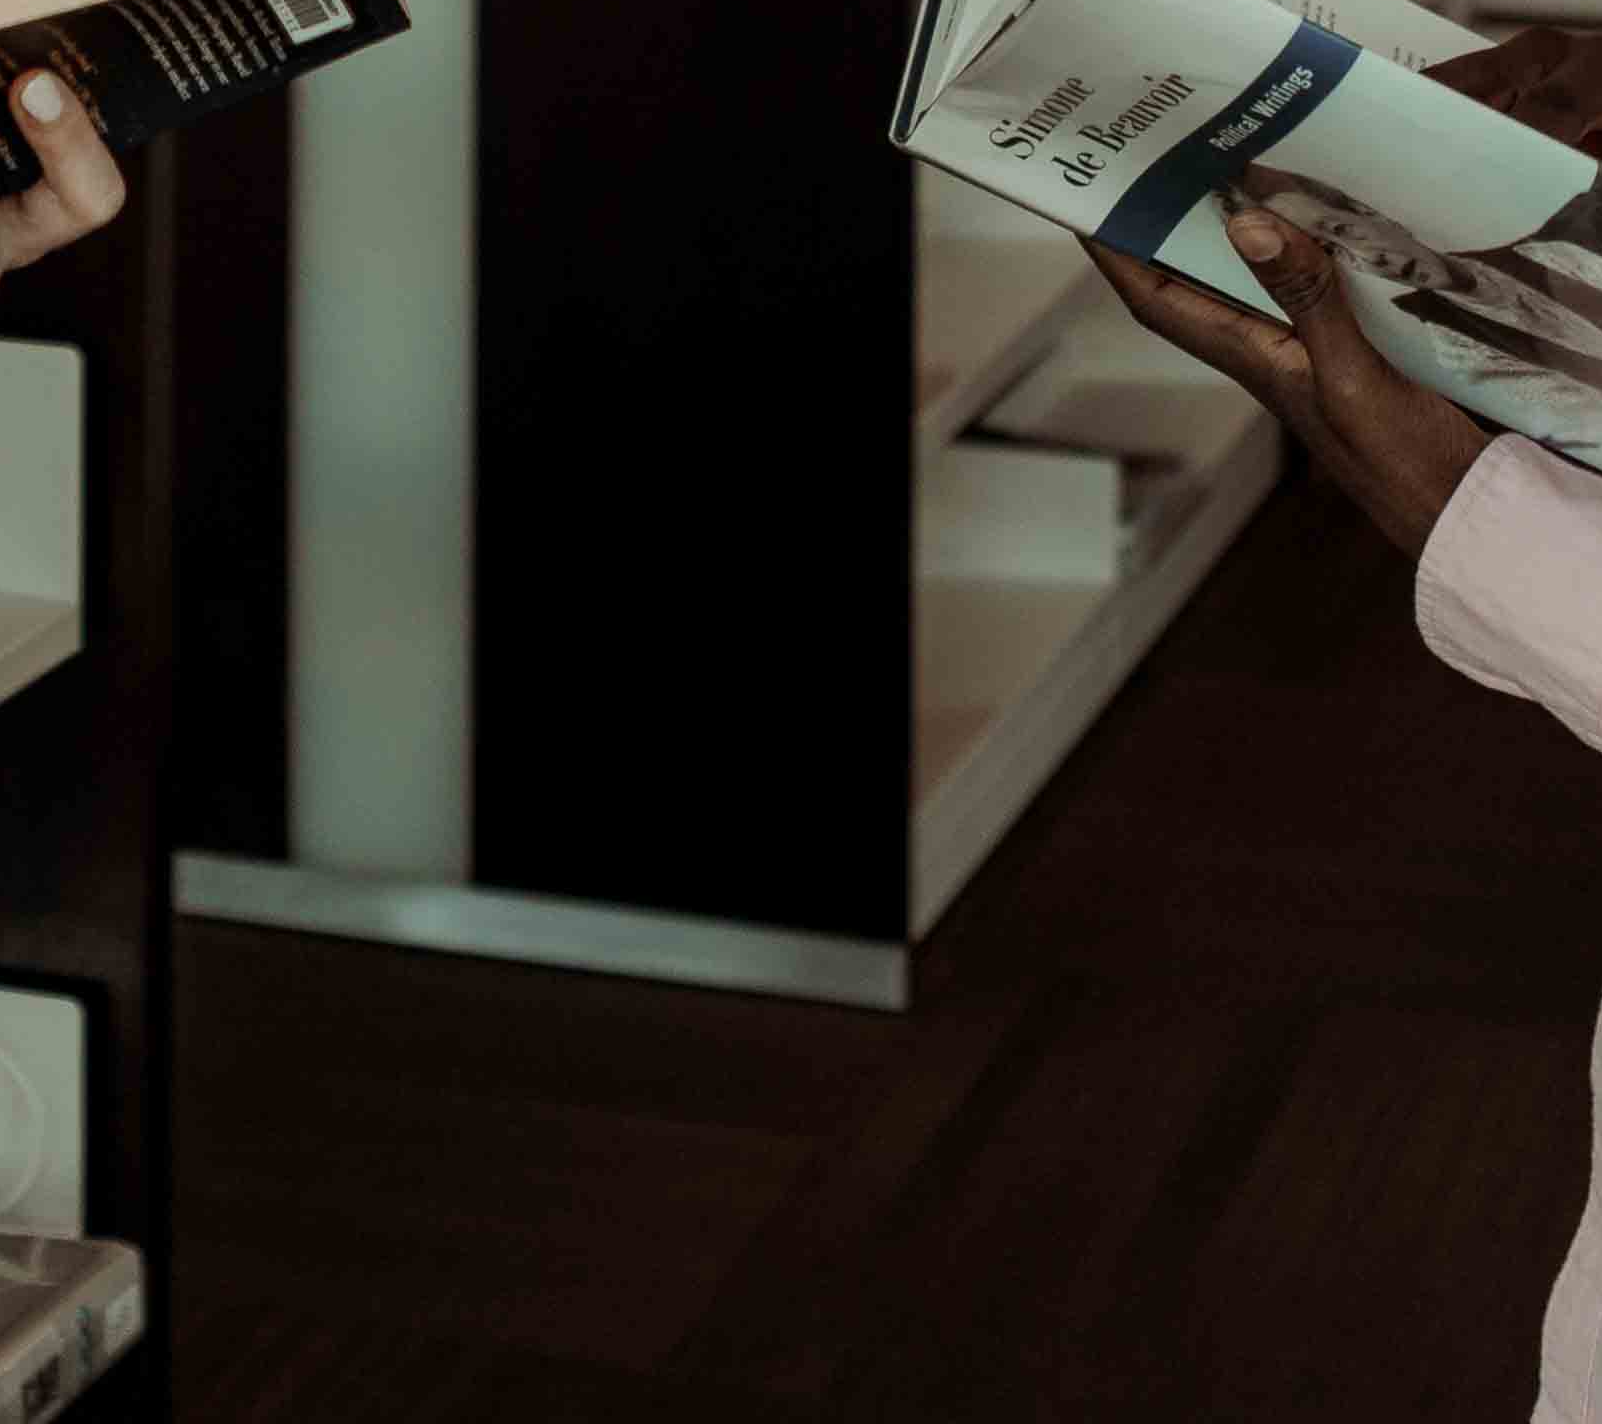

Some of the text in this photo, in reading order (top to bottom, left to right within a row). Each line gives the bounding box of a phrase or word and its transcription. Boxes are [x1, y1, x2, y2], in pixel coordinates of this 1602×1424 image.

[987, 75, 1096, 161] Simone
[1050, 71, 1197, 189] de Beauvoir
[1207, 62, 1316, 153] Political Writings
